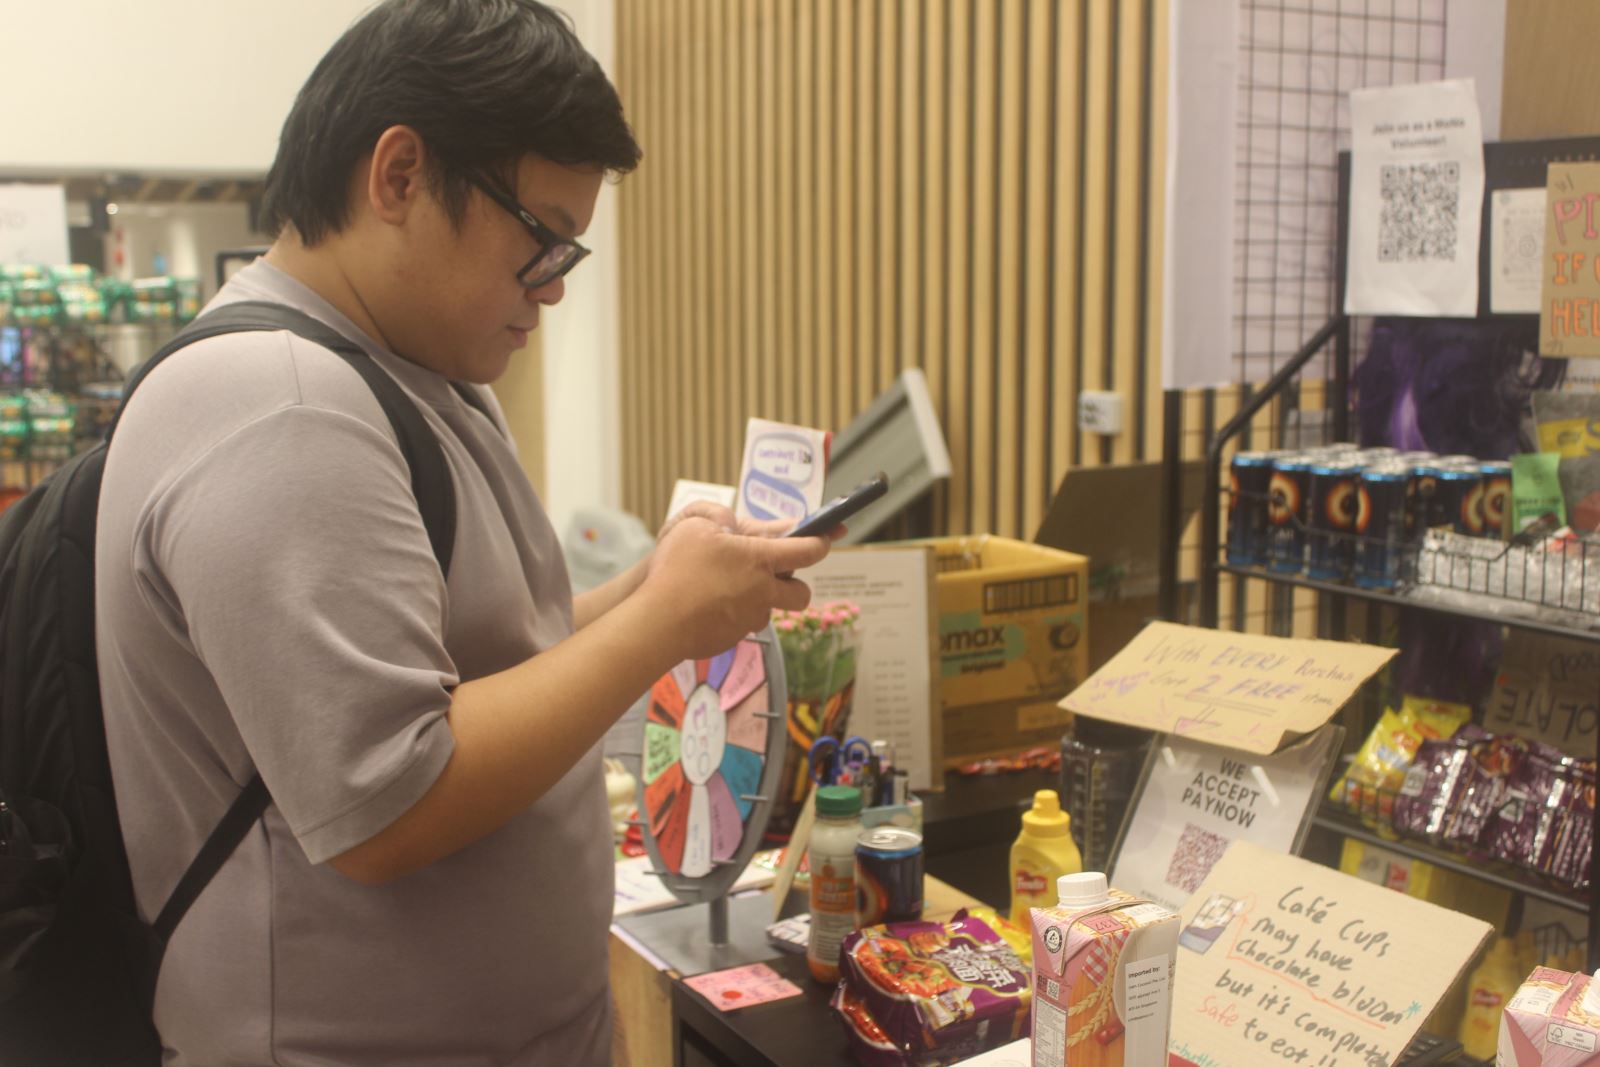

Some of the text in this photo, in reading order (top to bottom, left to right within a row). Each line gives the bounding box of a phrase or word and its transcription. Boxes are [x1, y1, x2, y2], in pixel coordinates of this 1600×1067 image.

[1552, 193, 1600, 245] PI
[1552, 252, 1585, 285] IF
[1210, 645, 1290, 671] EVERY
[1228, 678, 1303, 699] FREE
[1220, 757, 1246, 781] WE
[1181, 787, 1256, 828] PAYNOW
[1192, 771, 1260, 807] ACCEPT
[1277, 886, 1337, 925] Café
[1250, 917, 1353, 972] may have
[1128, 967, 1152, 979] Imported
[1215, 968, 1254, 998] but
[1257, 985, 1291, 1016] it's
[1243, 1017, 1268, 1043] to
[1270, 1036, 1310, 1065] eat
